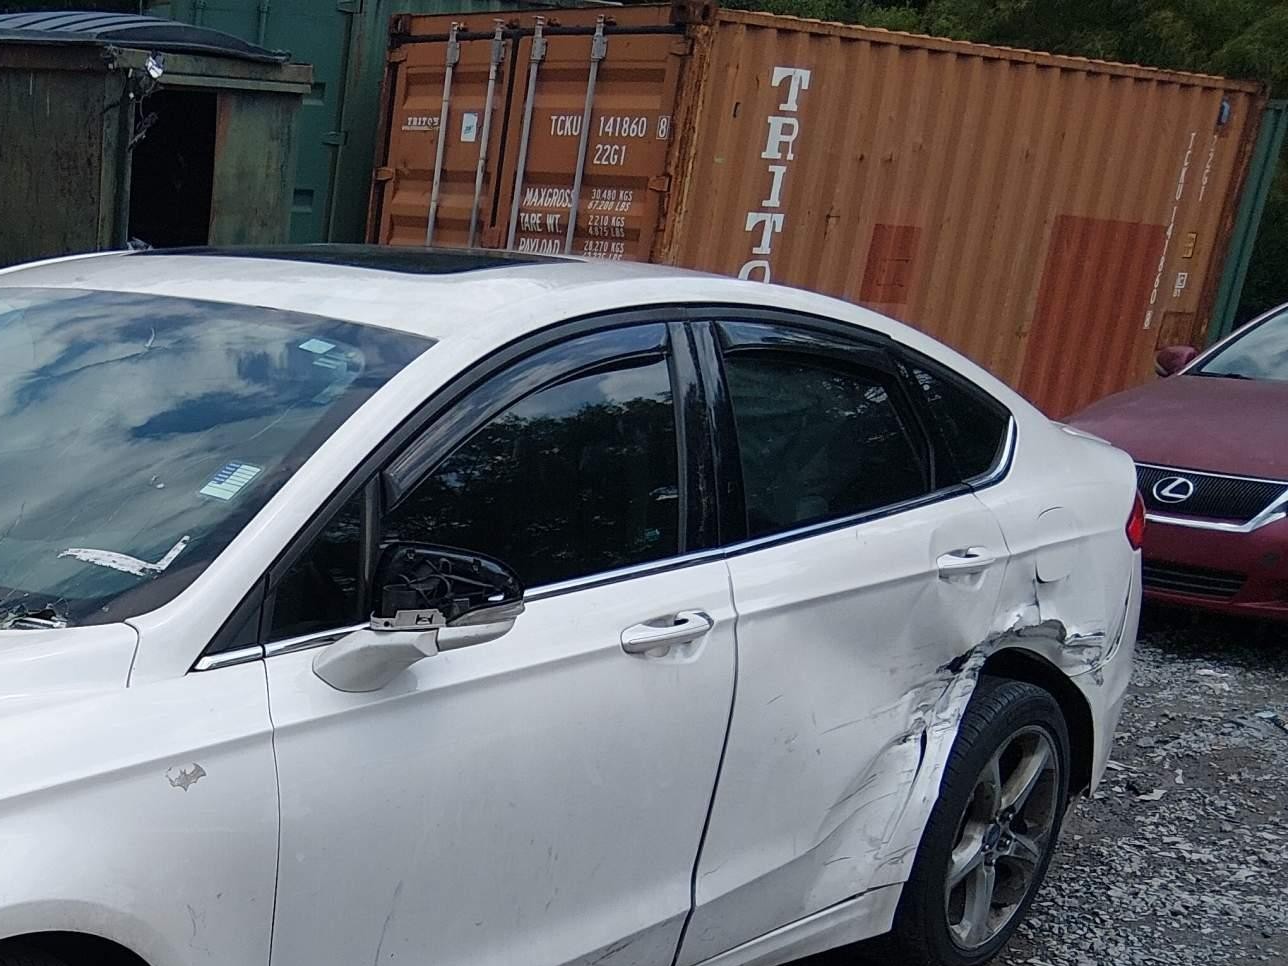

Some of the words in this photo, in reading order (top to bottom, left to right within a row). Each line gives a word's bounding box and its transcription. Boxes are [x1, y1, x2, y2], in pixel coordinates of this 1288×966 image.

[550, 115, 582, 137] TCKU
[598, 115, 647, 138] 141860
[658, 117, 669, 138] 8
[593, 143, 626, 166] 22G1
[618, 190, 633, 202] KGS
[615, 201, 631, 212] LBS
[519, 213, 543, 232] TARE
[611, 216, 625, 228] KGS
[611, 227, 625, 238] LBS
[518, 238, 560, 254] PAYLOAD
[611, 242, 625, 254] KGS
